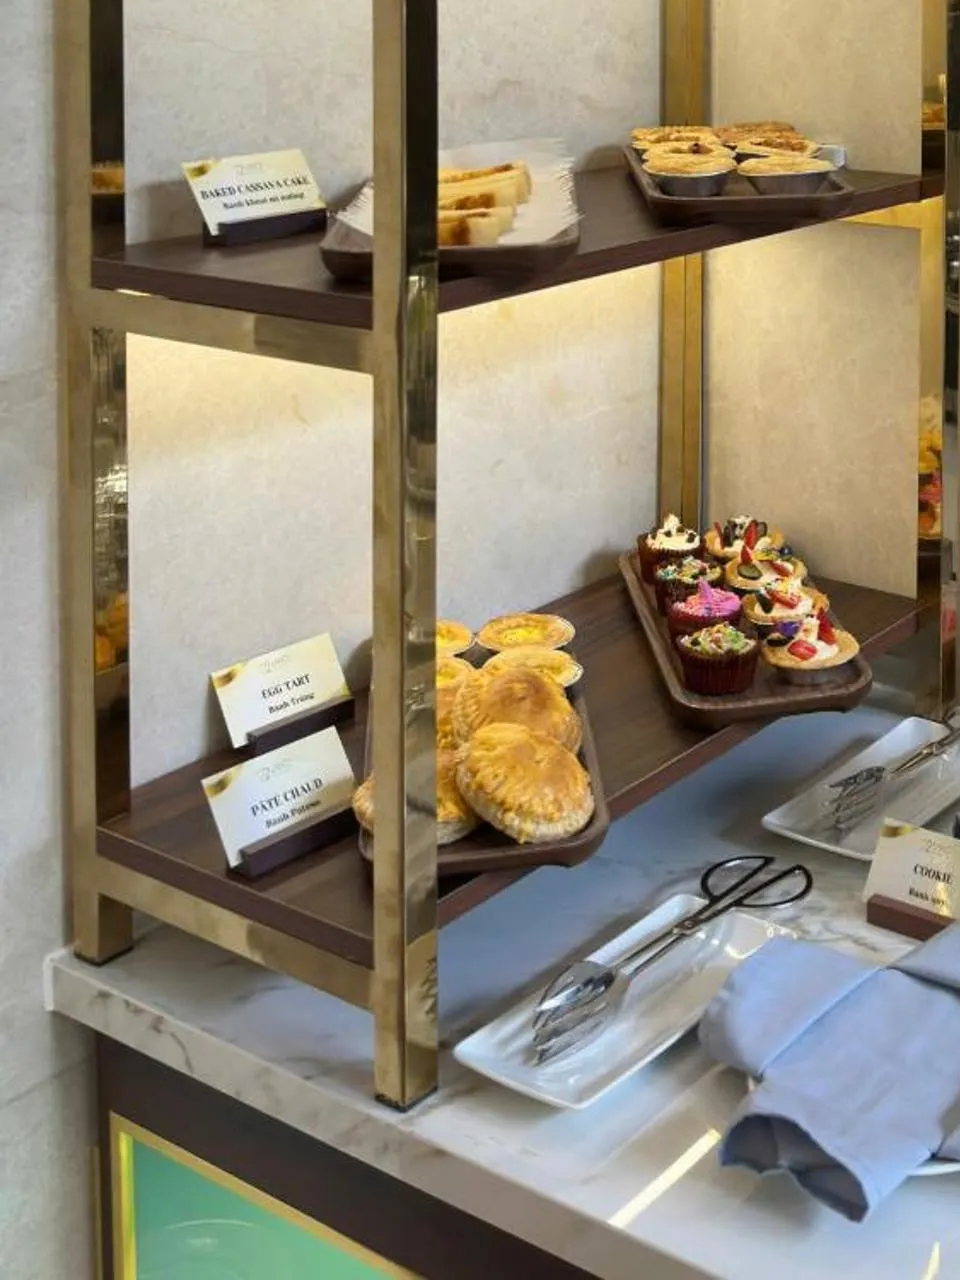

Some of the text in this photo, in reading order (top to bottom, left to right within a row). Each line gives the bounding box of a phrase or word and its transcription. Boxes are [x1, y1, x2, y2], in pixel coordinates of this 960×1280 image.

[200, 175, 311, 200] BAKED CASSAVA CAKE
[262, 673, 310, 699] EGG TART
[283, 777, 324, 801] CHAUD
[913, 863, 953, 885] COOKIE
